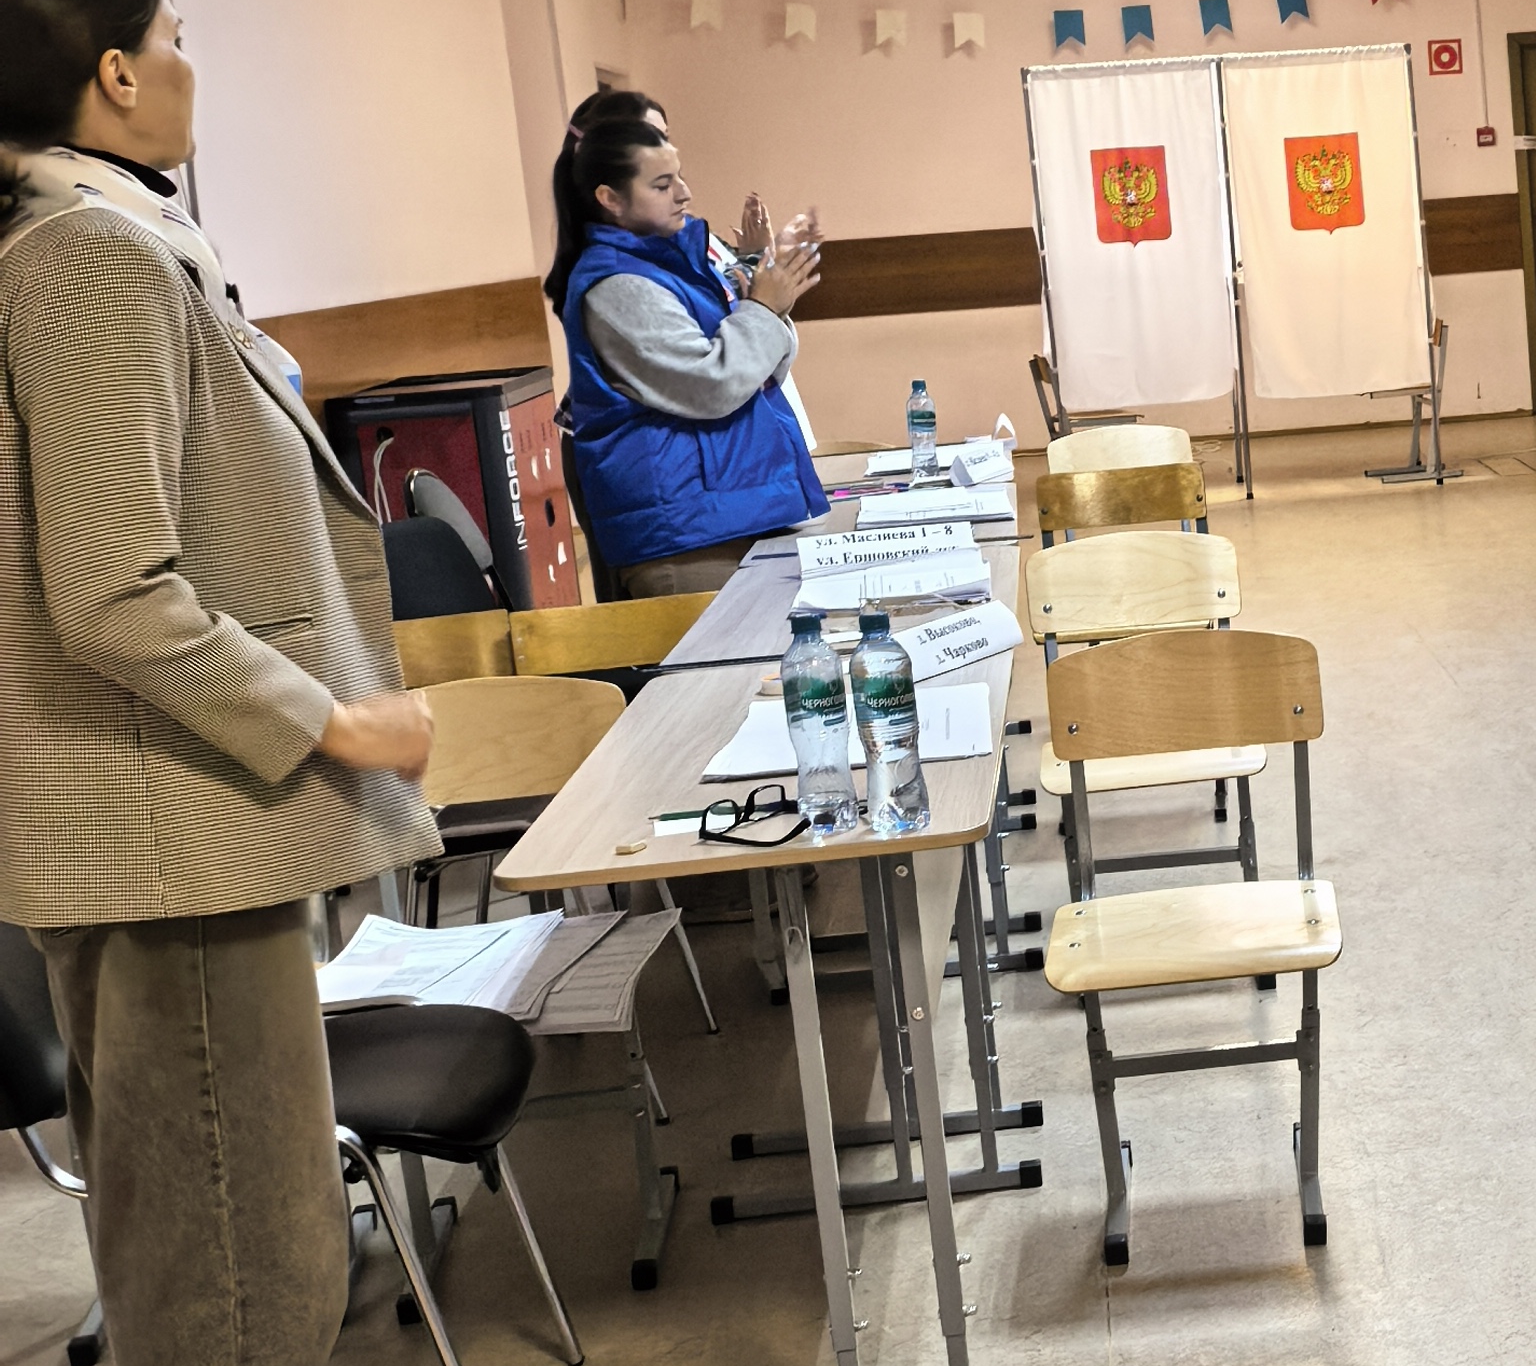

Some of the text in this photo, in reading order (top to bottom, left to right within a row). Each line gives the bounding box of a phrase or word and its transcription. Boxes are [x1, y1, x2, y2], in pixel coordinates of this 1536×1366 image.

[499, 410, 529, 551] INFORCE
[815, 536, 837, 549] ул.
[944, 525, 953, 536] 8
